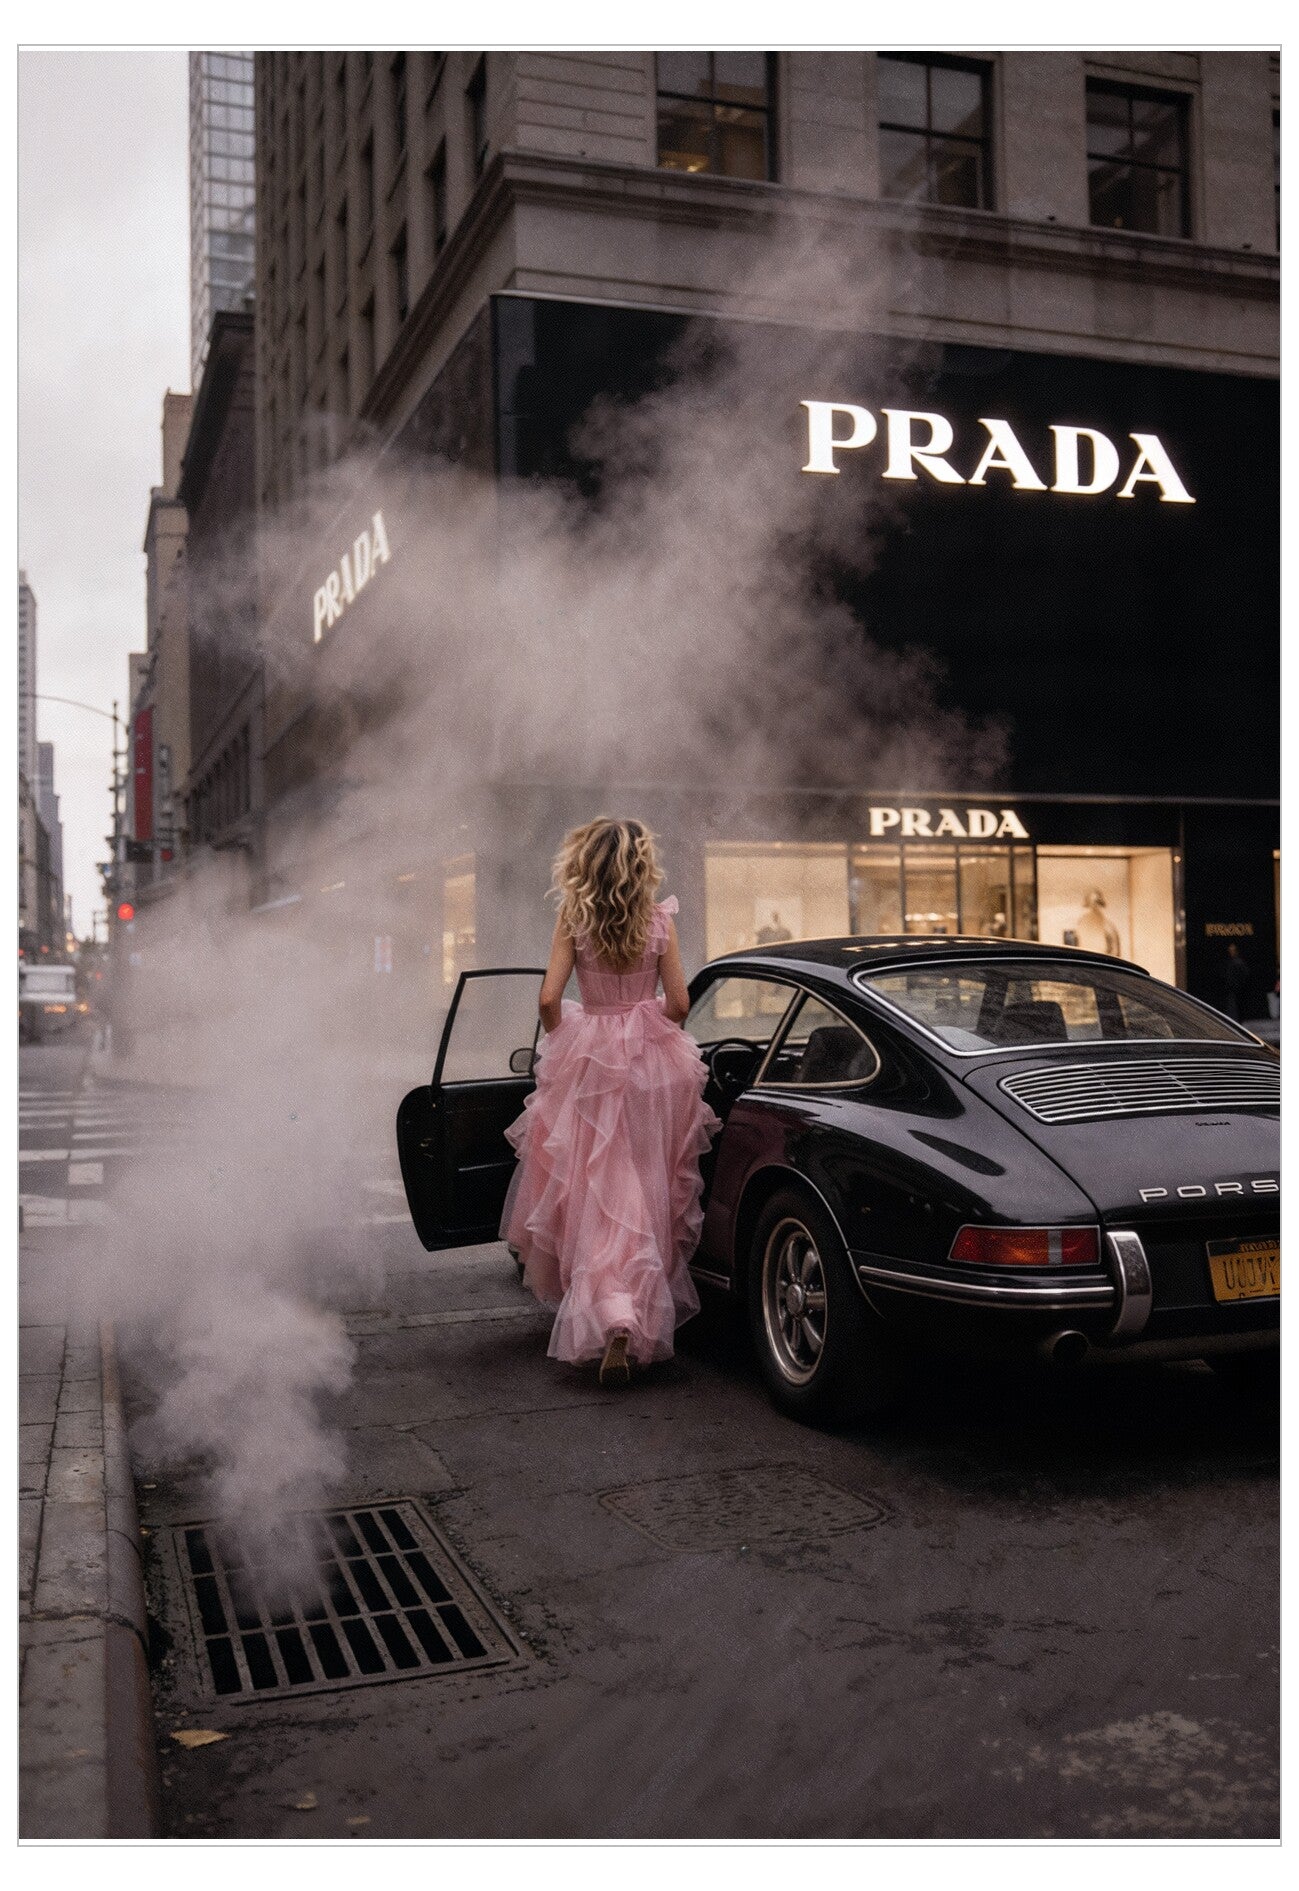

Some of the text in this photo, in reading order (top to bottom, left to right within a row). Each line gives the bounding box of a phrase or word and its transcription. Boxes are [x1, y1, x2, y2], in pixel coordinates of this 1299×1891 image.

[801, 400, 1197, 503] PRADA
[314, 510, 392, 643] PRADA
[869, 807, 1030, 838] PRADA
[1139, 1179, 1280, 1203] PORS
